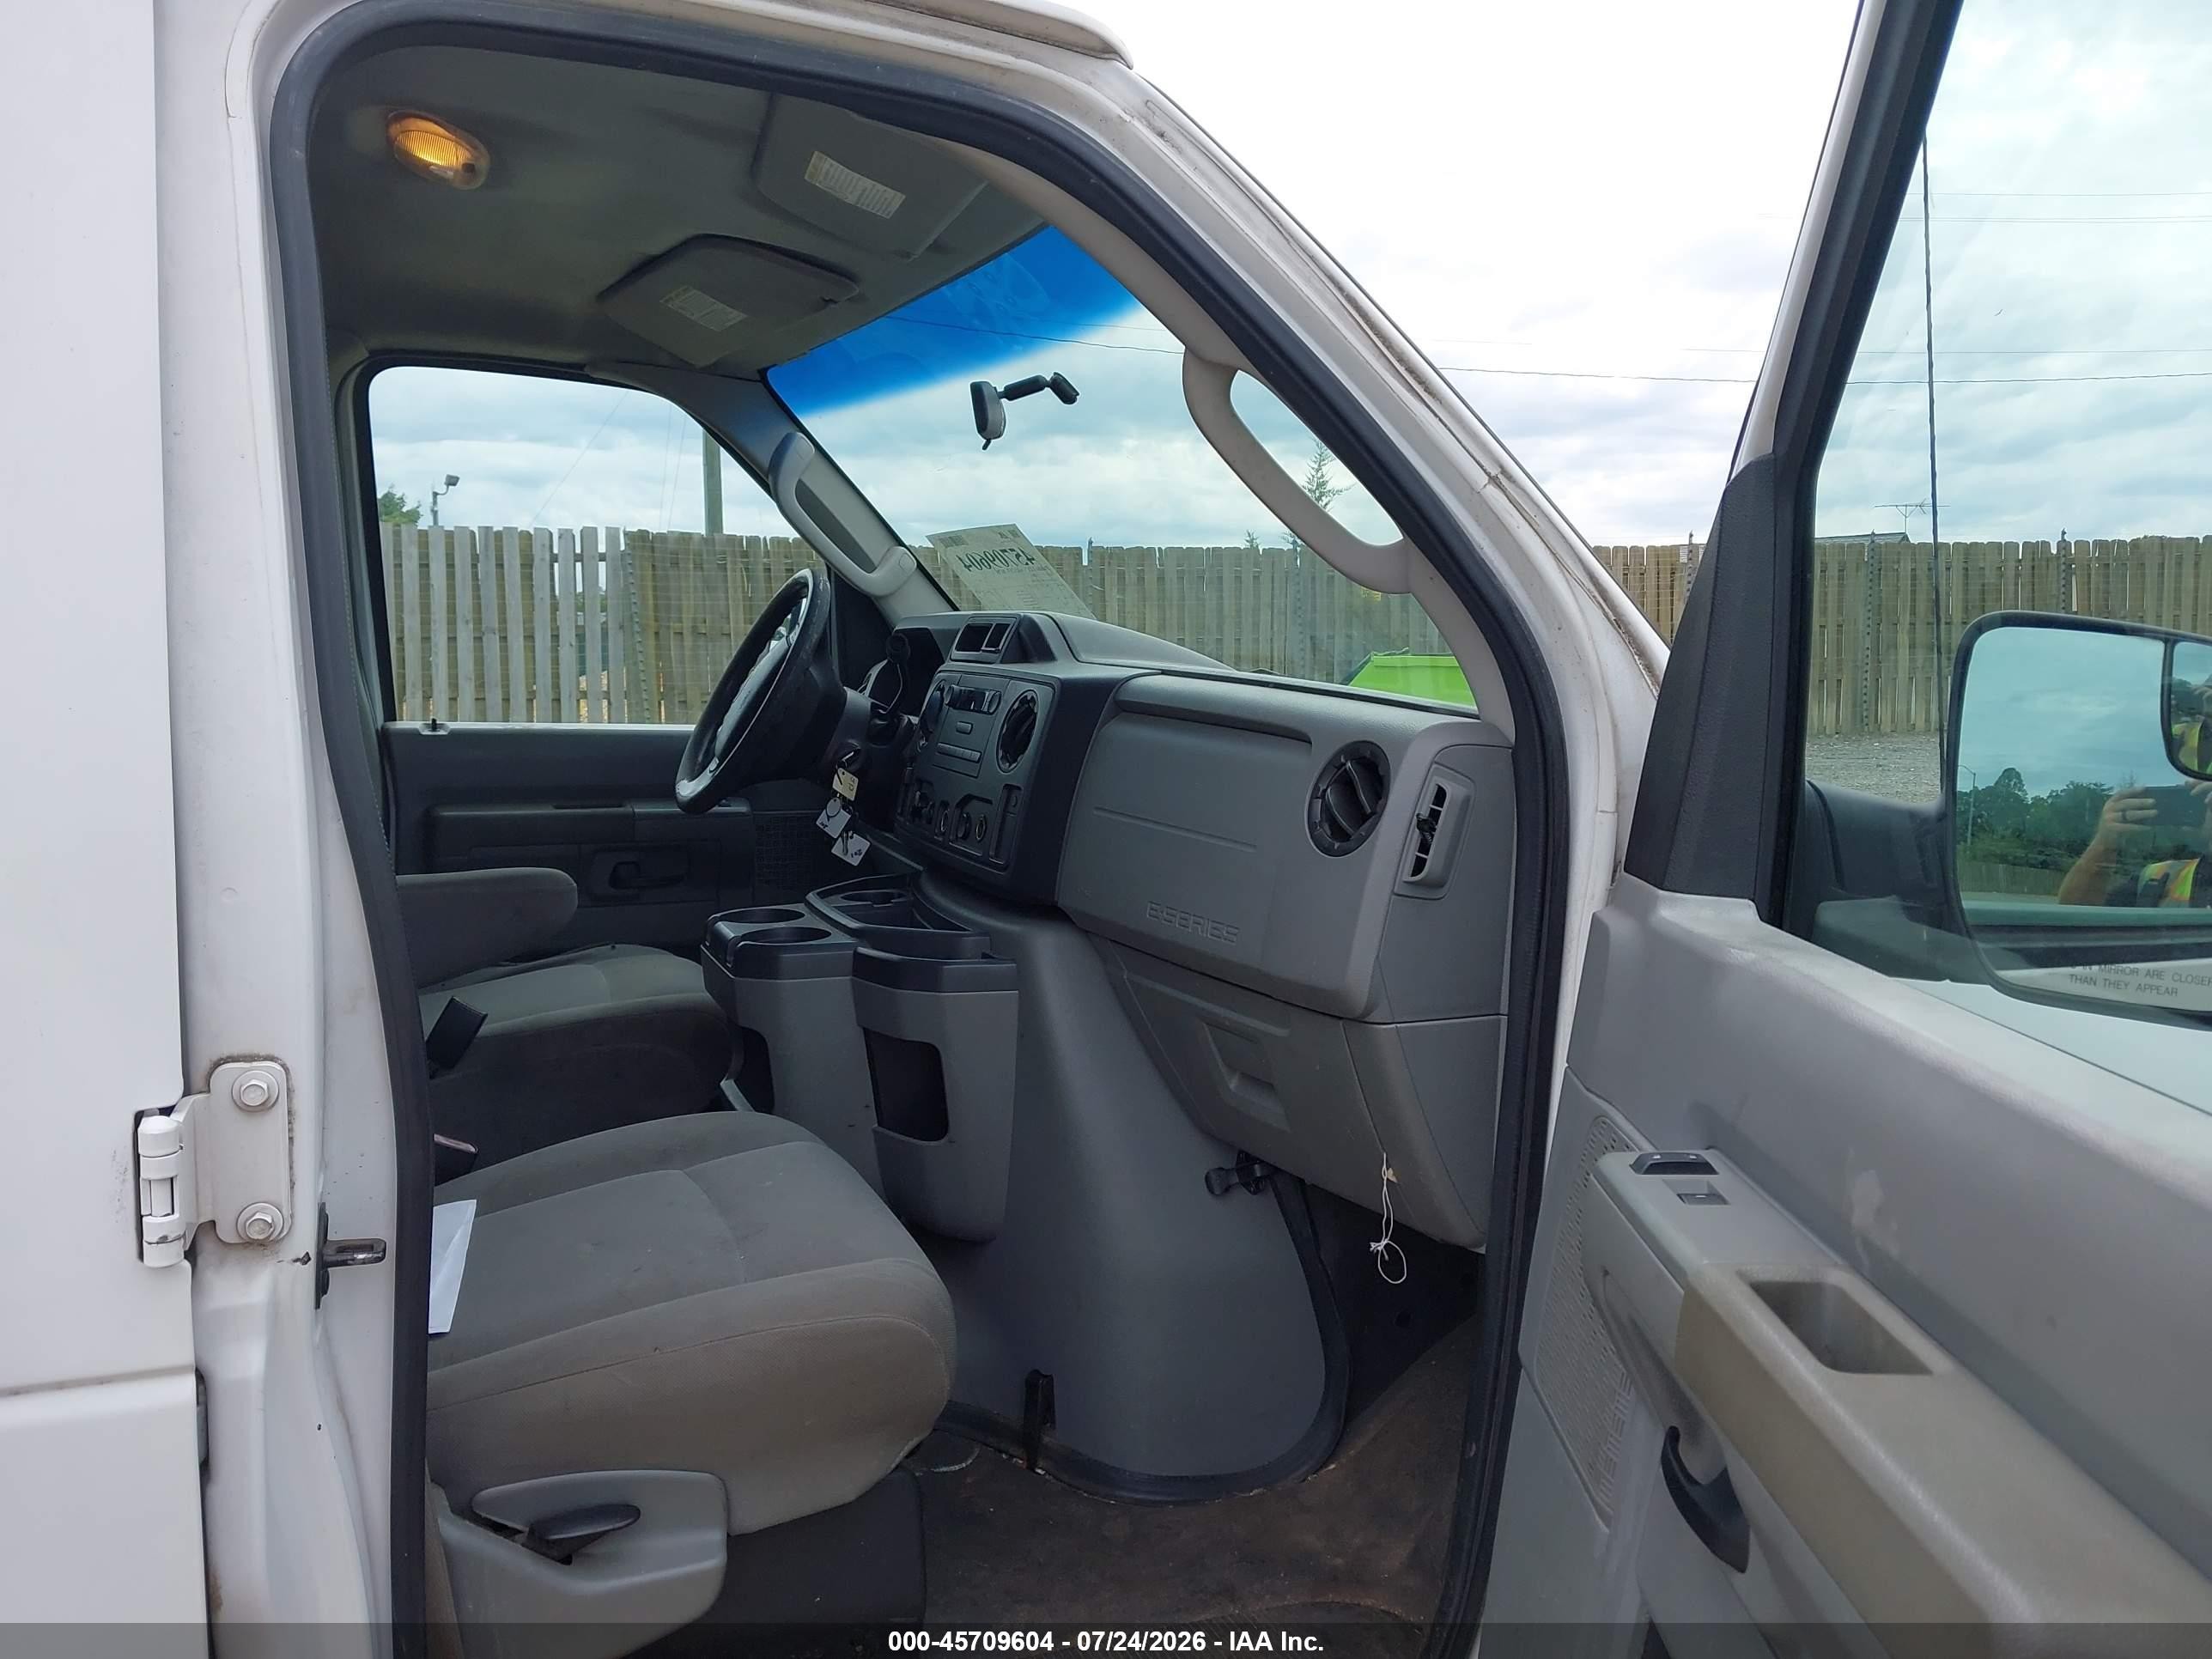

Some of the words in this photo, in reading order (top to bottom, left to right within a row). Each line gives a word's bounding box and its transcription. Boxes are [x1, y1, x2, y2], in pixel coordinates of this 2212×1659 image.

[2098, 963, 2139, 976] MIRROR
[2144, 969, 2165, 981] ARE
[2069, 974, 2097, 987] THAN
[2104, 978, 2130, 990] THEY
[2136, 983, 2179, 996] APPEAR
